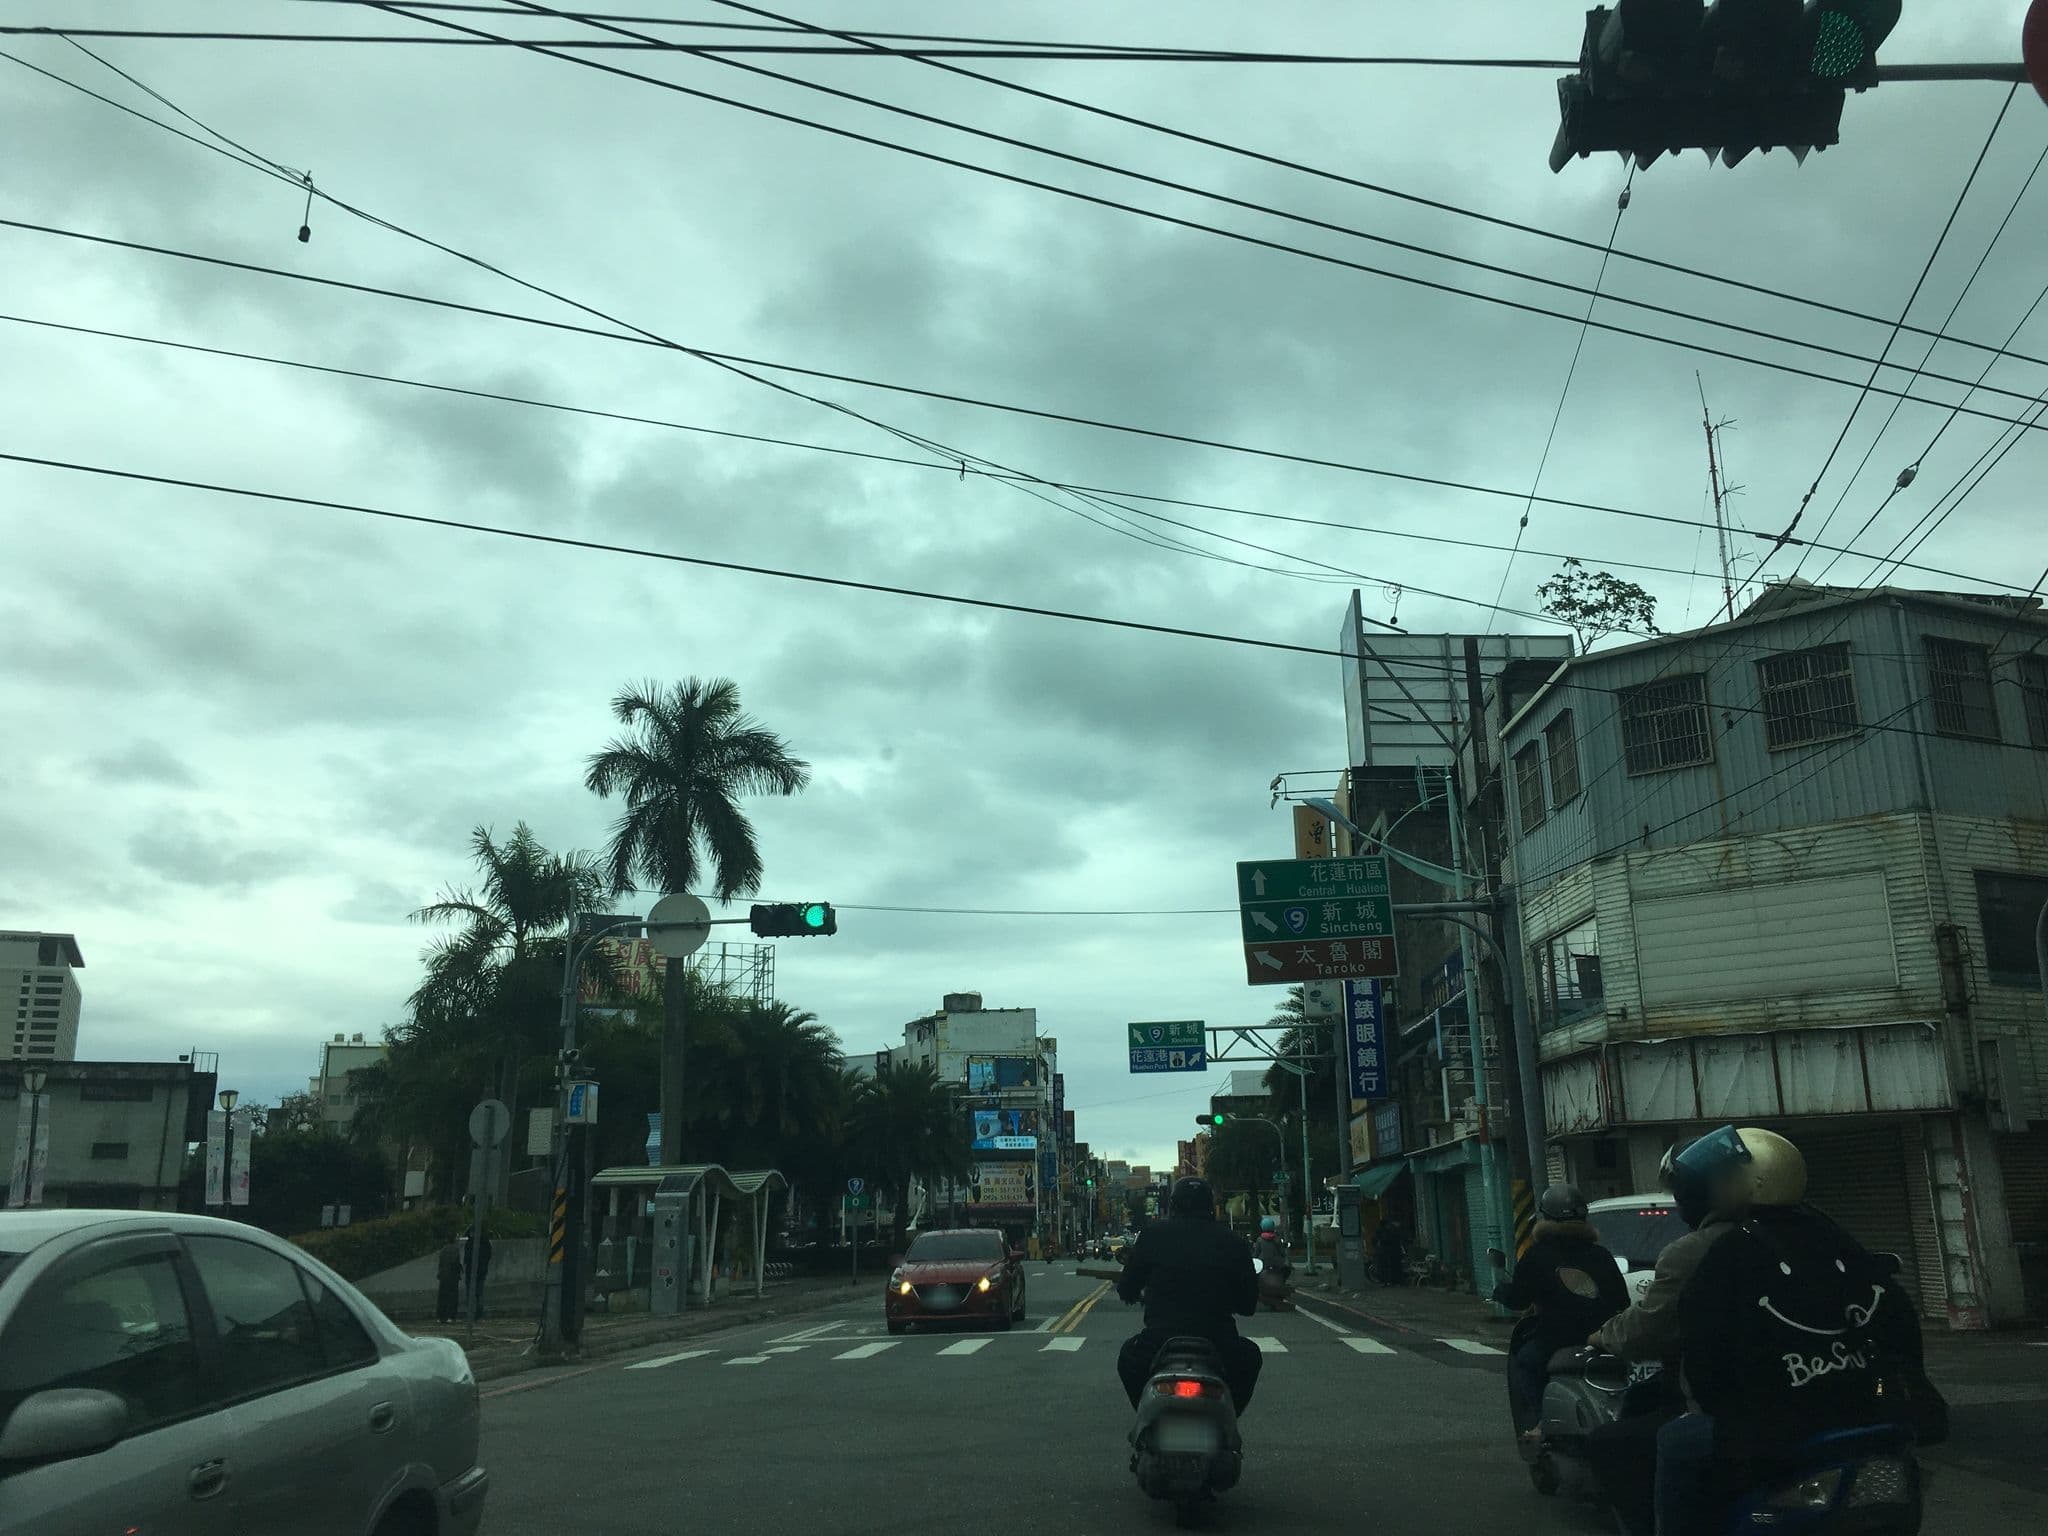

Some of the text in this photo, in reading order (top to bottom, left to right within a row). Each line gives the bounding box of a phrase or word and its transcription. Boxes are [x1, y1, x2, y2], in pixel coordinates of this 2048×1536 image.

[1311, 861, 1382, 881] 花蓮市區
[1299, 883, 1387, 896] Central Hualien
[1323, 902, 1377, 921] 新城
[1290, 912, 1304, 928] 9
[1320, 922, 1382, 934] Sincheng
[1296, 940, 1382, 964] 太魯閣
[1315, 964, 1365, 975] Taroko
[1131, 1049, 1168, 1062] 花蓮港
